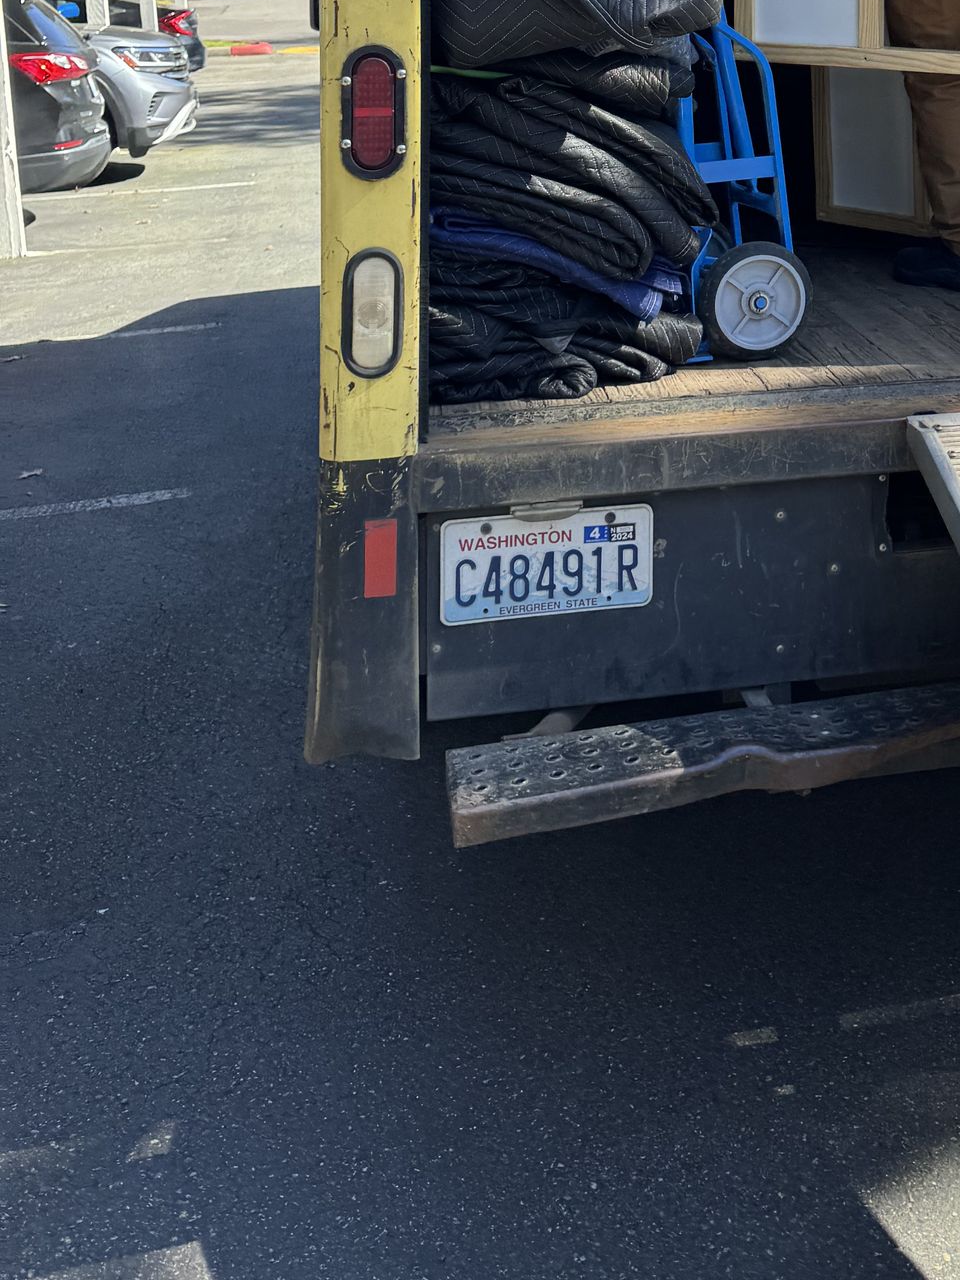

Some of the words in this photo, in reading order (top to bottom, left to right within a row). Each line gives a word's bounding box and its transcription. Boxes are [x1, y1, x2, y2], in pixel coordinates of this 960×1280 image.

[458, 529, 572, 552] WASHINGTON
[590, 526, 601, 539] 4
[611, 532, 633, 541] 2024
[455, 543, 639, 607] C48491R
[499, 600, 561, 615] EVERGREEN
[566, 597, 598, 608] STATE
